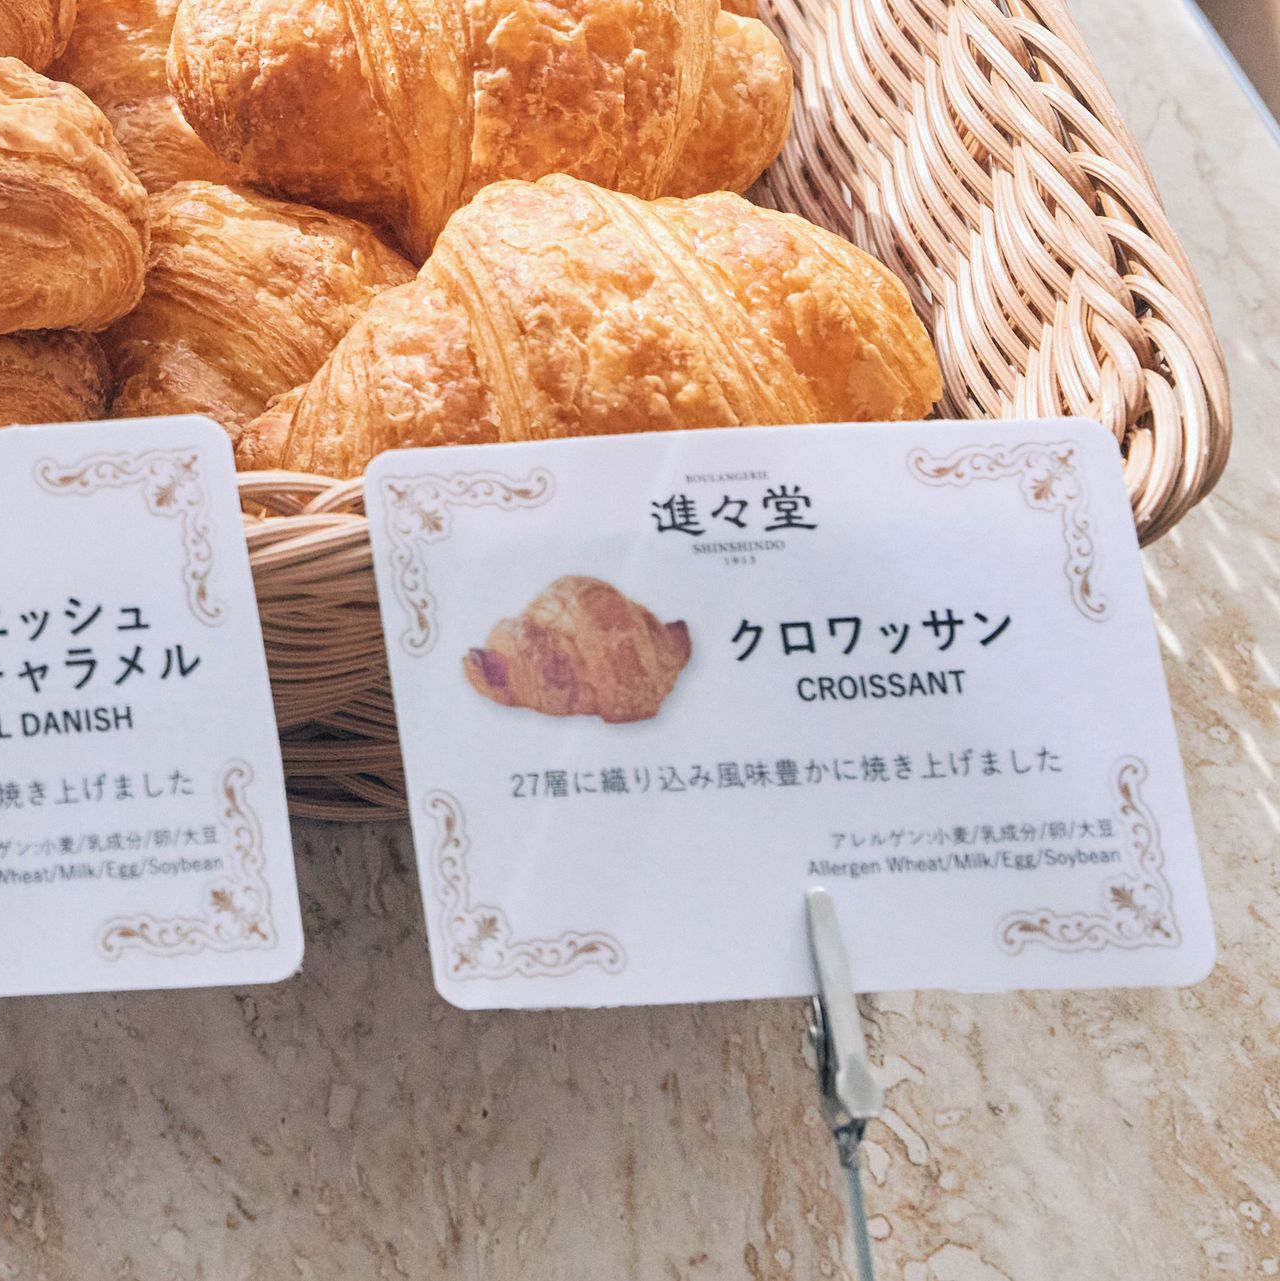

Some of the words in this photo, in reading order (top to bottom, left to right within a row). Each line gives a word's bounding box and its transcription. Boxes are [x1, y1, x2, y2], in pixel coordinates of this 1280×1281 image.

[650, 484, 818, 537] 進々堂
[692, 540, 786, 554] SHINSHINDO
[731, 609, 1012, 662] クロワッサン
[796, 669, 966, 703] CROISSANT
[20, 705, 134, 738] DANISH
